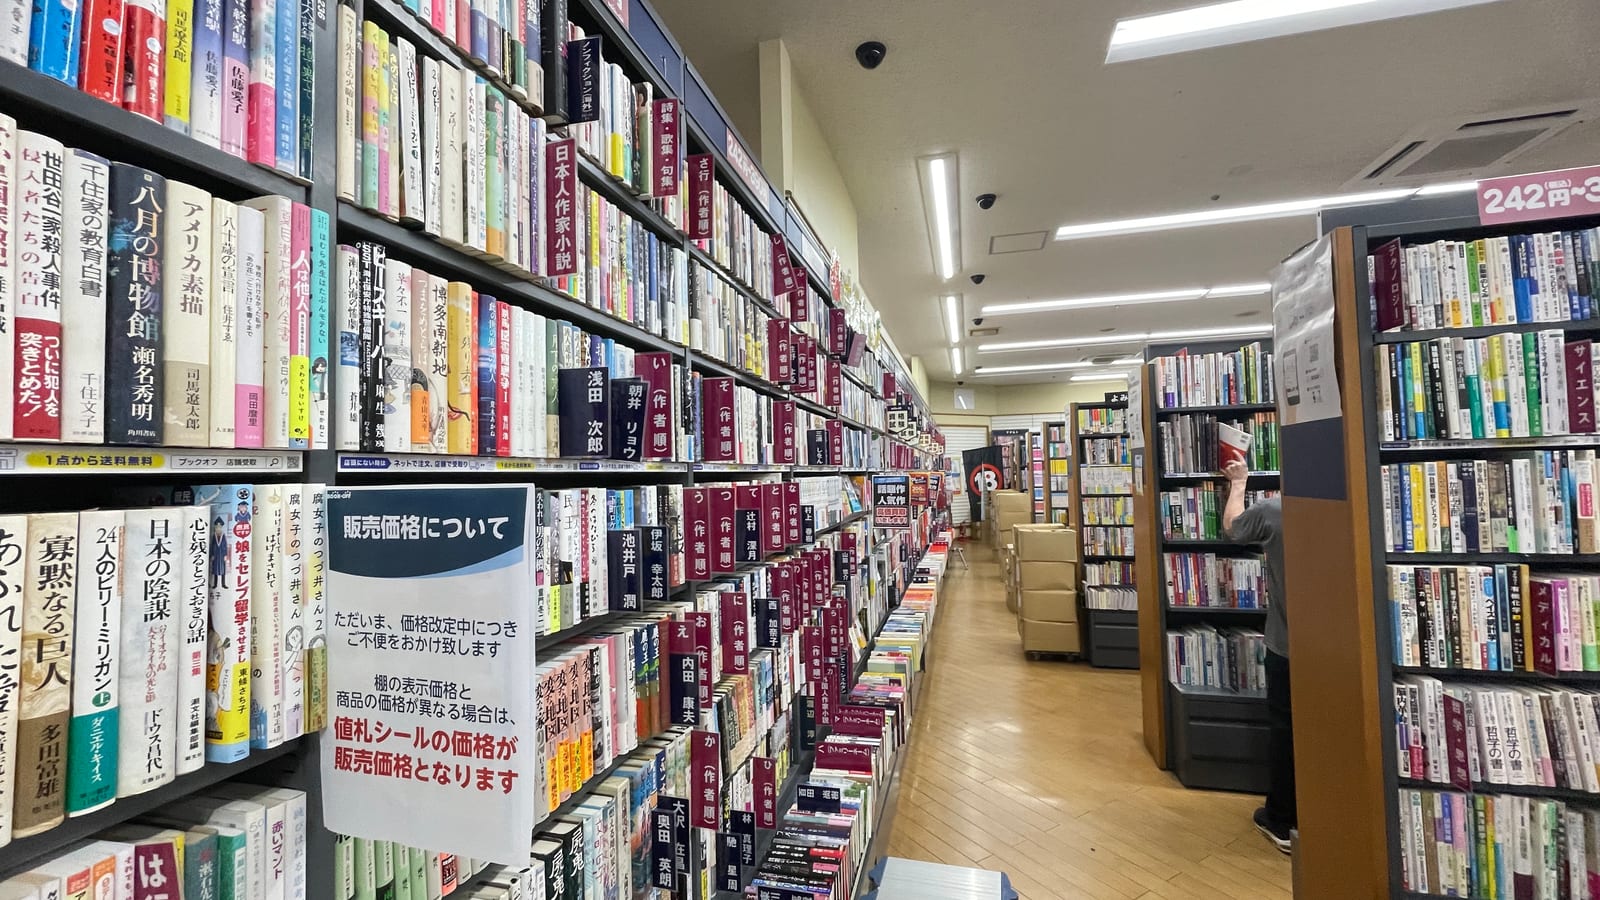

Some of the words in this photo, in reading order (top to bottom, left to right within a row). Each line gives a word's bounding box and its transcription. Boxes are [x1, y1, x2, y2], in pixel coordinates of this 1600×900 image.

[174, 9, 188, 63] 司馬遼太郎
[206, 50, 219, 98] 佐藤愛子
[231, 66, 245, 114] 佐藤愛子
[660, 102, 674, 188] 詩集・歌集・句集
[41, 150, 62, 310] 世田谷一家殺人事件
[79, 163, 105, 298] 千住家の教育白書
[554, 144, 572, 271] 日本人作家小説
[128, 185, 163, 343] 八月の博物館
[180, 200, 204, 316] アメリカ素描
[291, 249, 311, 312] 人は他人
[1388, 244, 1400, 320] テクノロジー
[318, 232, 328, 344] ほむら先生はたぶんモテない
[417, 279, 428, 366] つまをめとらば
[431, 285, 447, 378] 博多南新地
[43, 336, 61, 418] ついに犯人を
[79, 373, 98, 429] 千住文子
[131, 345, 156, 422] 瀬名秀明
[185, 368, 201, 431] 司馬遼太郎
[298, 364, 306, 422] さわぐちけいすけ
[587, 371, 603, 403] 浅田
[627, 384, 642, 410] 朝井
[1573, 344, 1591, 425] サイエンス
[248, 392, 259, 427] 岡田麿里
[318, 409, 326, 438] せかねこ
[652, 357, 668, 453] い（作者順）
[719, 380, 732, 457] そ（作者順）
[127, 429, 156, 437] 角川書店
[587, 420, 603, 454] 次郎
[623, 422, 637, 460] リョウ
[46, 454, 153, 467] 1点から送料無料
[178, 457, 218, 466] ブックオフ
[226, 457, 257, 467] 店舗受取
[974, 470, 998, 494] 18
[343, 514, 509, 541] 販売価格について
[562, 494, 575, 530] 民王
[694, 492, 706, 576] う（作者順）
[719, 491, 732, 568] つ（作者順）
[771, 486, 782, 548] と（作者順）
[265, 534, 276, 588] はげまされて
[289, 493, 301, 620] 腐女子のつづ井さん
[312, 493, 325, 632] 腐女子のつづ井さん2
[622, 533, 636, 579] 池井戸
[650, 528, 663, 552] 伊坂
[747, 540, 757, 561] 深月
[143, 518, 172, 623] 日本の陰謀
[187, 517, 209, 644] 心に残るとっておきの話
[651, 563, 664, 599] 幸太郎
[34, 535, 75, 692] 寡黙なる巨人
[93, 526, 118, 692] 24人のビリー・ミリガン
[234, 540, 250, 663] 娘をセレブ留学させまし
[334, 611, 519, 638] ただいま、価格改定中につき
[623, 593, 637, 610] 潤
[768, 600, 778, 611] 西
[1536, 585, 1552, 664] メディカル
[347, 632, 502, 659] ご不便をおかけ致します
[733, 595, 746, 672] に（作者順）
[768, 619, 778, 647] 加奈子
[191, 650, 202, 677] 第三集
[374, 673, 473, 701] 棚の表示価格と
[682, 657, 694, 683] 内田
[98, 691, 110, 705] 上
[189, 697, 200, 751] 潮文社編集部編
[335, 689, 516, 726] 商品の価格が異なる場合は、
[682, 696, 695, 724] 康夫
[36, 723, 62, 799] 多田富雄
[90, 716, 106, 784] ダニエル・キイス
[145, 708, 163, 774] ドウス昌代
[333, 715, 520, 762] 値札シールの価格が
[333, 746, 520, 795] 販売価格となります
[703, 735, 716, 825] か（作者順）
[657, 815, 671, 844] 奥田
[741, 813, 752, 824] 林
[271, 820, 284, 880] 赤いマント
[658, 857, 672, 887] 英朗
[742, 833, 752, 864] 真理子
[727, 864, 738, 891] 星周
